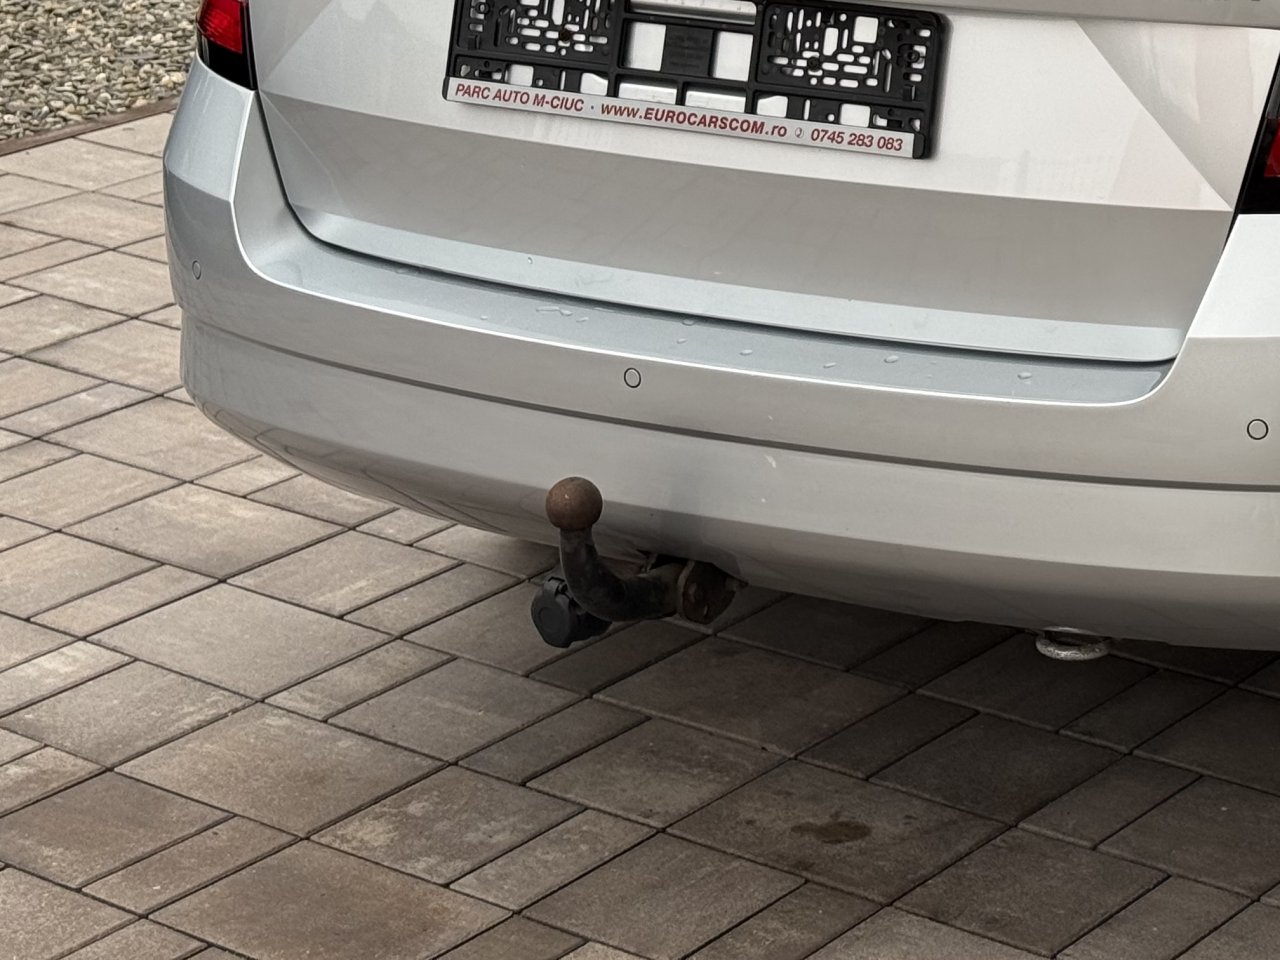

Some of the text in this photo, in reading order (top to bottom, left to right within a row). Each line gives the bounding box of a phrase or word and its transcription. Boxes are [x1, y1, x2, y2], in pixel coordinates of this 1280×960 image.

[454, 83, 491, 100] PARC
[492, 88, 531, 105] AUTO
[532, 93, 585, 112] M-CIUC
[810, 128, 845, 145] 0745
[849, 132, 874, 148] 283
[877, 135, 904, 152] 083
